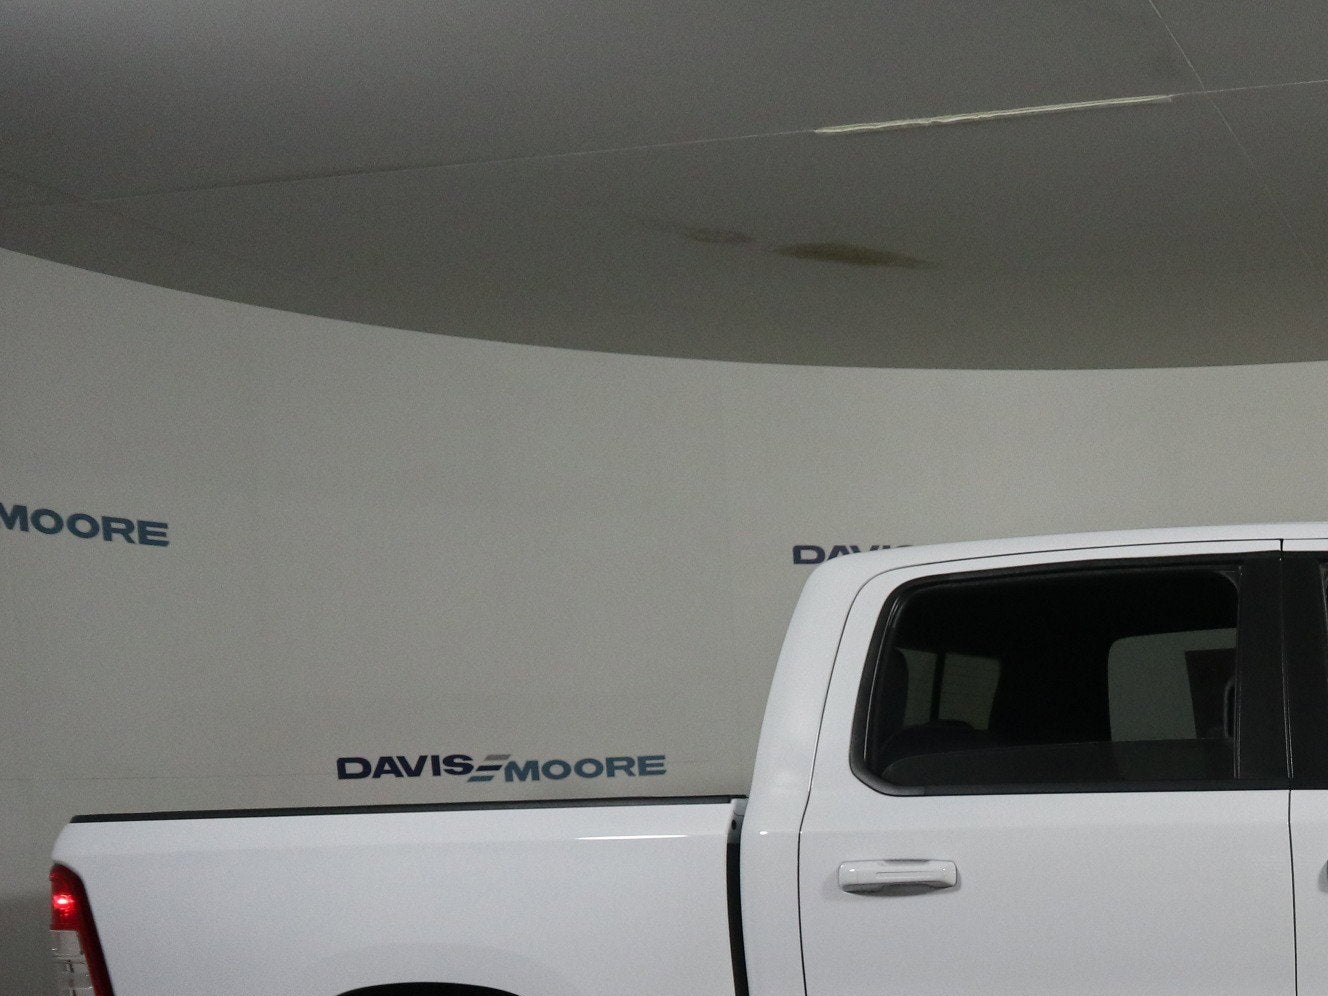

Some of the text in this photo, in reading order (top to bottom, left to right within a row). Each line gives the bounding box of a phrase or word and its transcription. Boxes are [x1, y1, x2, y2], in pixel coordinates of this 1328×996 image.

[0, 501, 169, 547] MOORE
[336, 754, 667, 782] DAVIS MOORE
